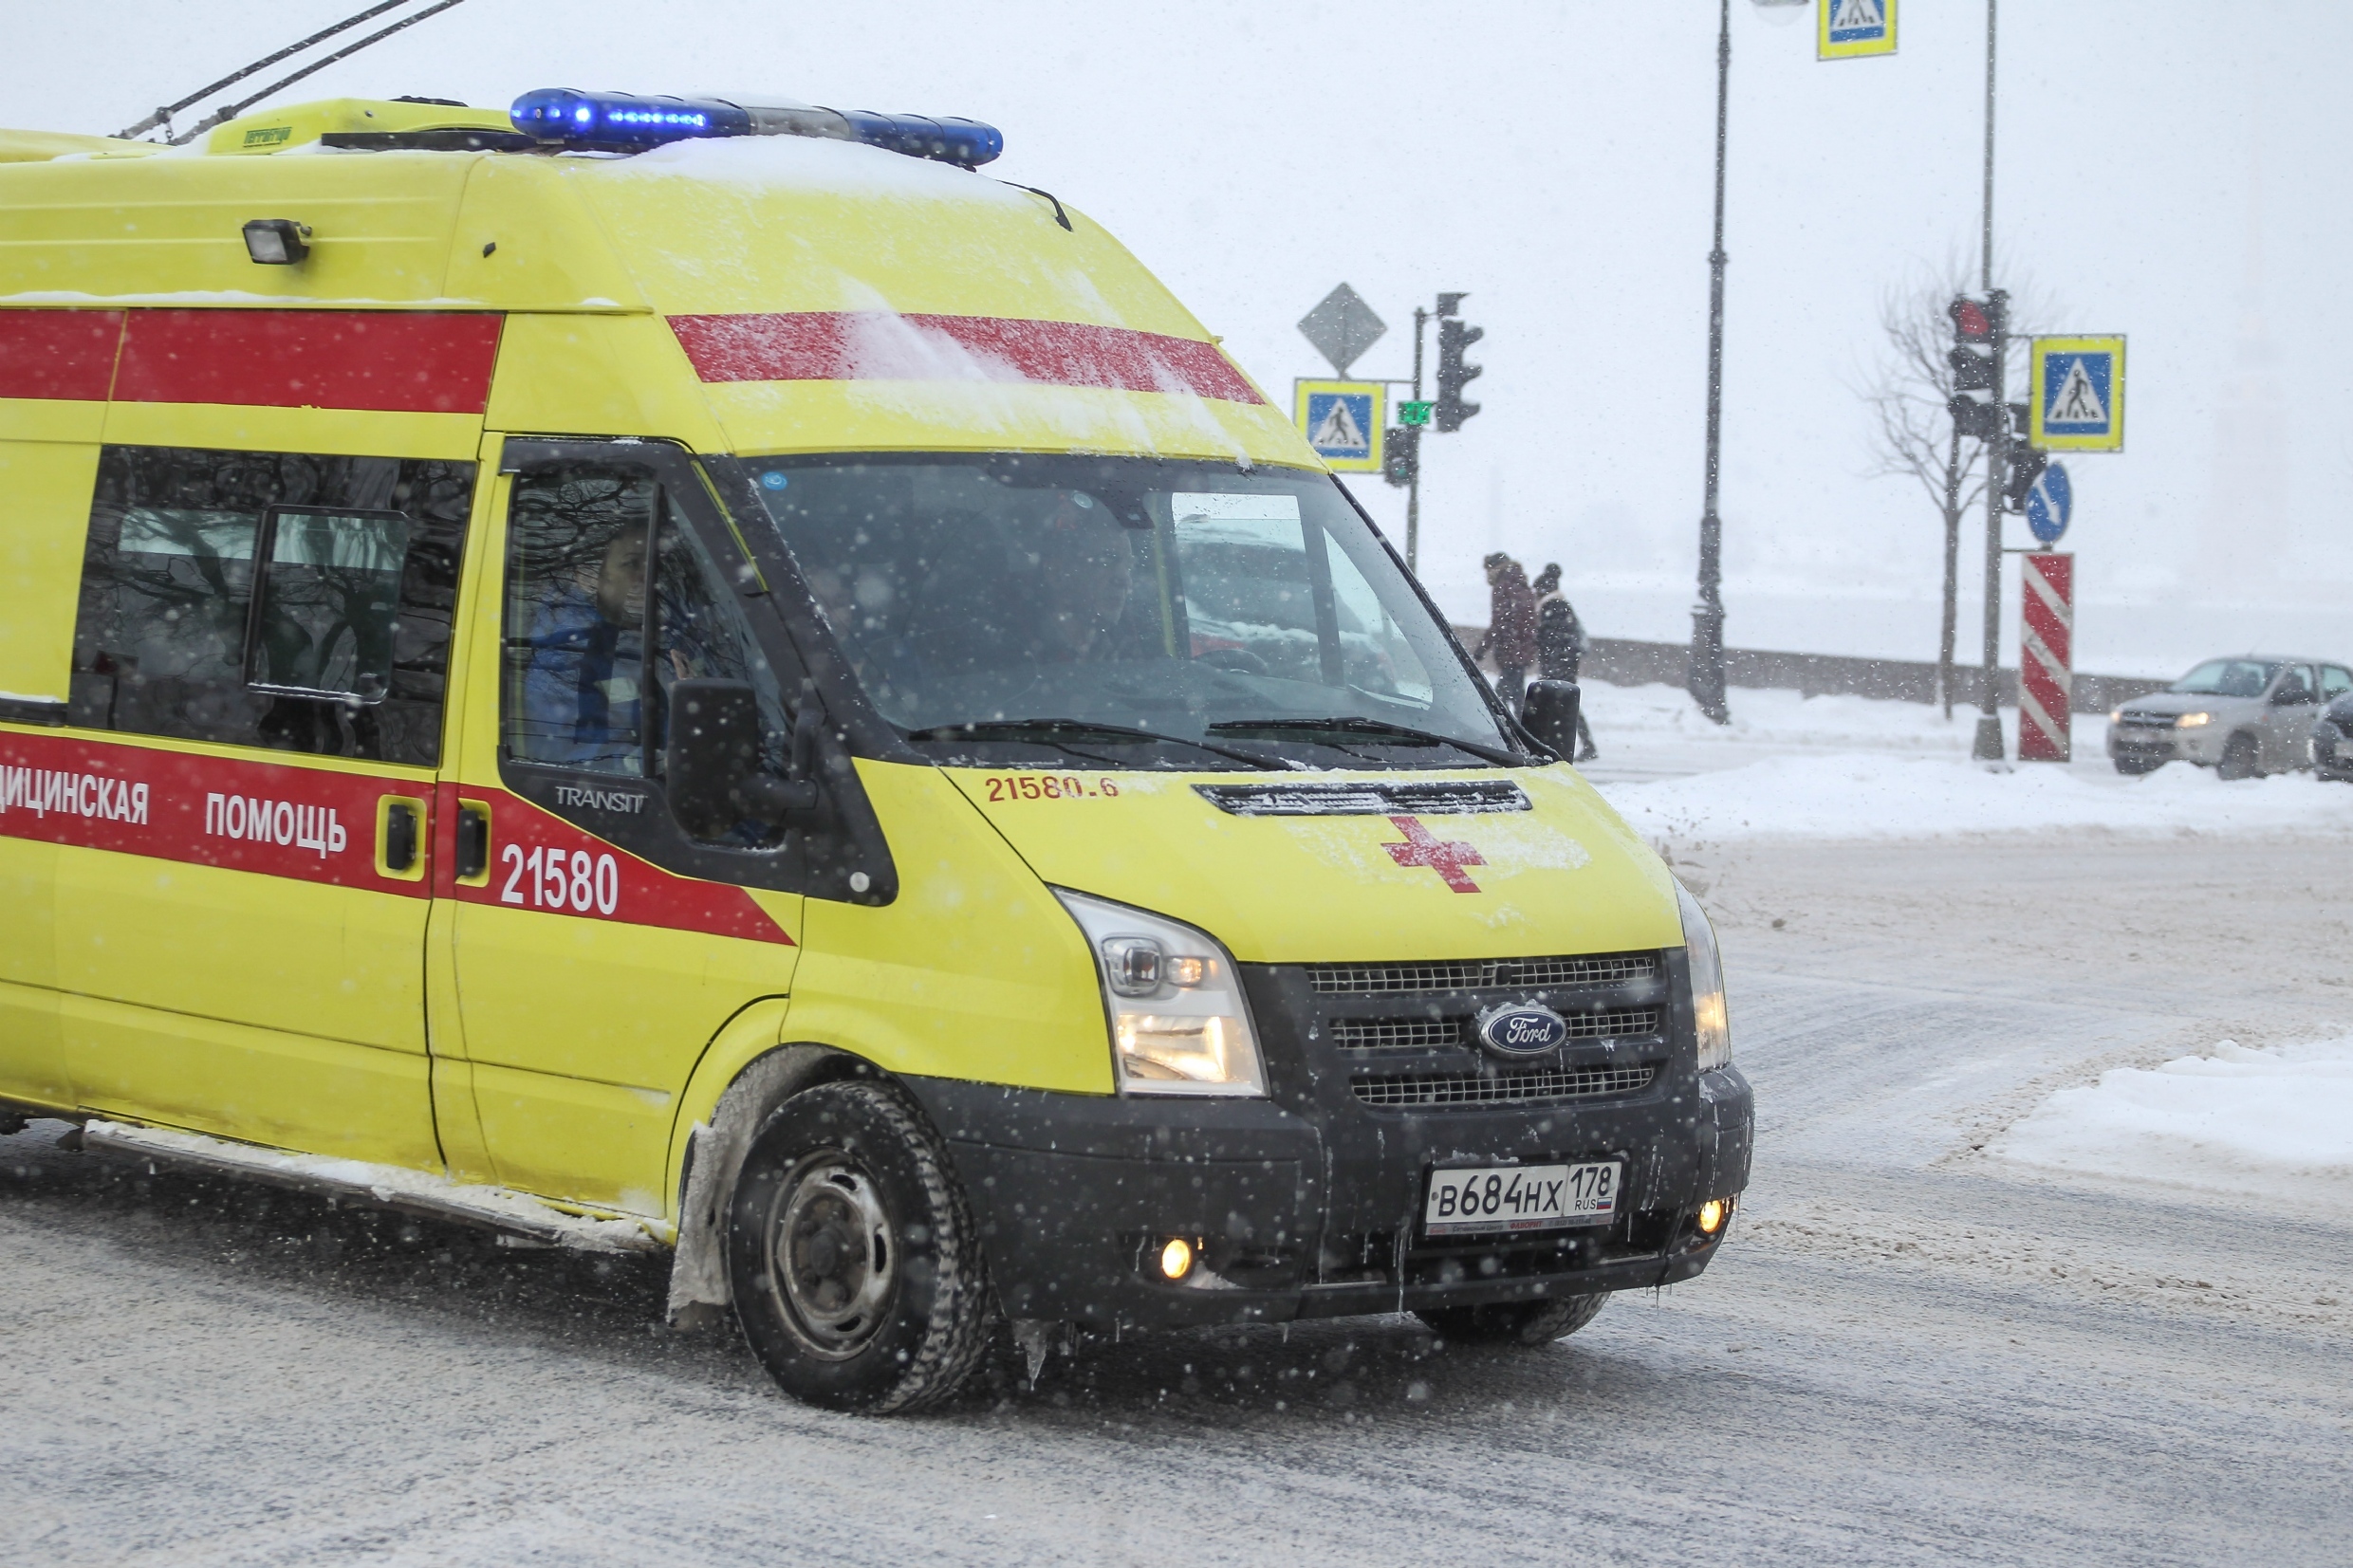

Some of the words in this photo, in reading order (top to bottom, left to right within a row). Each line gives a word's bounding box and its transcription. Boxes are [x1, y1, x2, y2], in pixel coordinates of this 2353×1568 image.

[554, 785, 648, 814] TRANSIT
[985, 775, 1120, 802] 21580.6
[0, 764, 150, 824] ИЦИНСКАЯ
[205, 792, 347, 859] ПОМОЩЬ
[501, 843, 619, 915] 21580
[1506, 1017, 1551, 1043] Ford
[1569, 1166, 1612, 1199] 178
[1574, 1198, 1597, 1211] RUS
[1510, 1220, 1543, 1229] ФАВОРИТ
